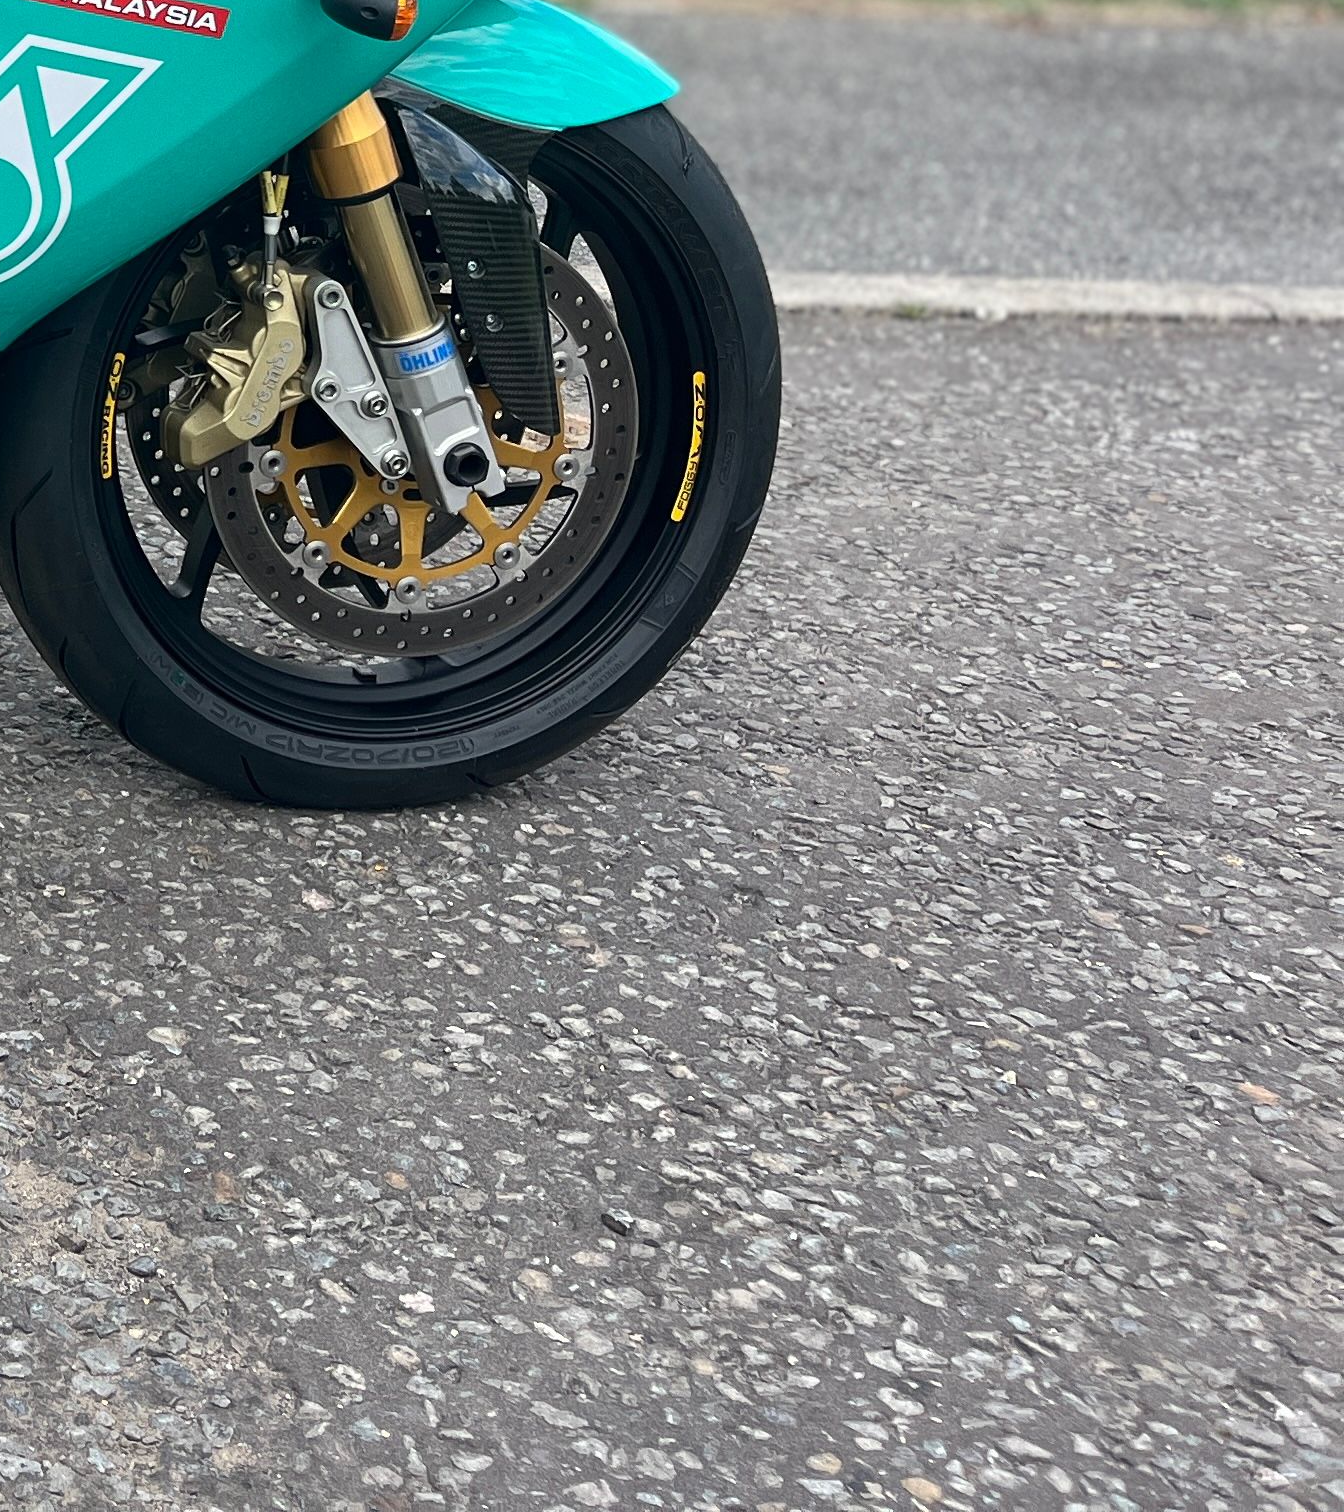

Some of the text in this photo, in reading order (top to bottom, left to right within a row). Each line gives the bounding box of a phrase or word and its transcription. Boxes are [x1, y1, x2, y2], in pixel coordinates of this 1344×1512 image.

[240, 338, 295, 428] brembo
[101, 405, 112, 475] RACING
[677, 461, 698, 512] FOGGY
